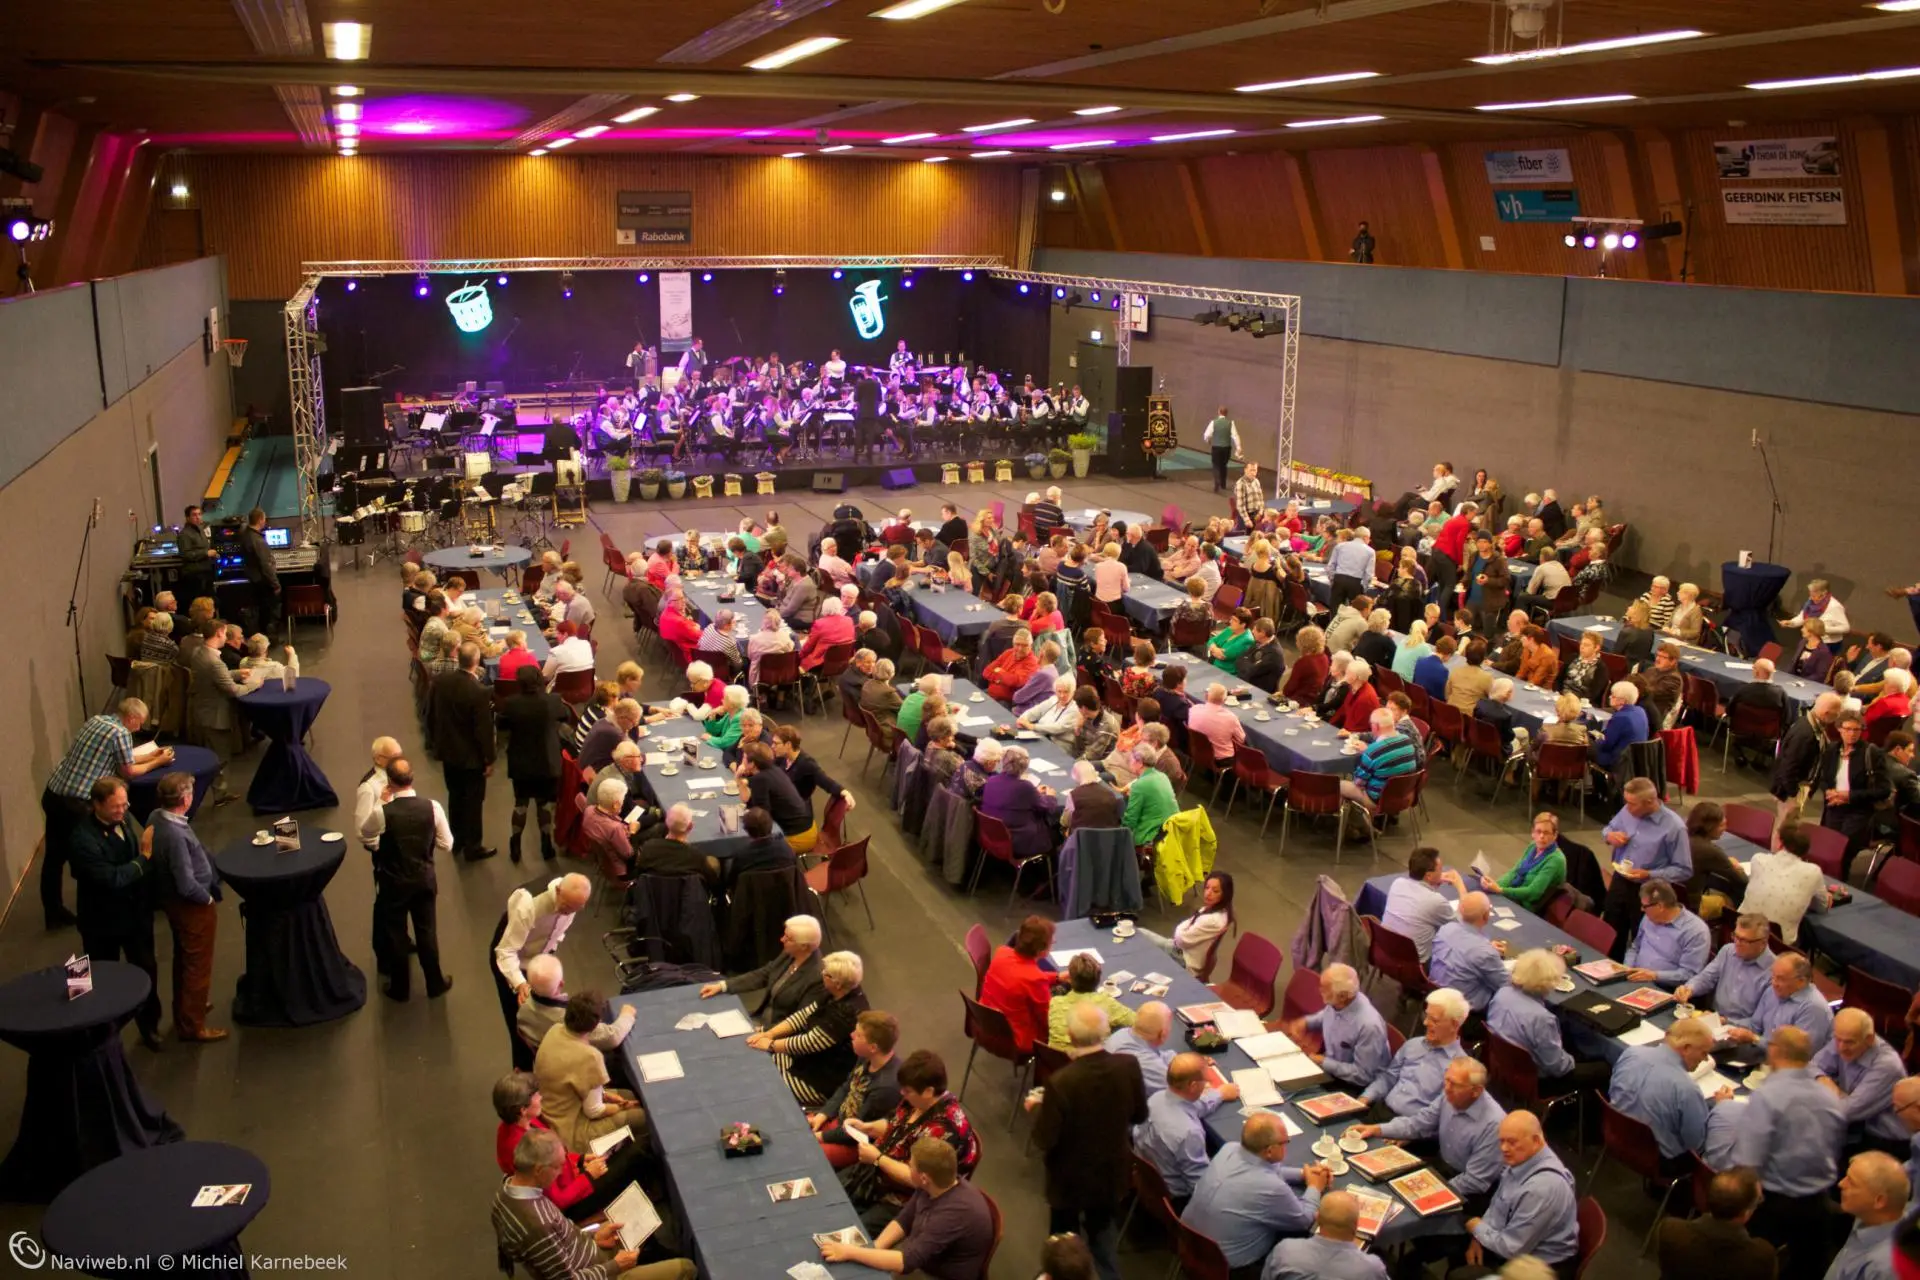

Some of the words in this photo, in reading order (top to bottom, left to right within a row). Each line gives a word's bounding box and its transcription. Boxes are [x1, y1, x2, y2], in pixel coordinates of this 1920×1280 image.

[1725, 192, 1786, 203] GEERDINK
[1788, 191, 1842, 203] FIETSEN
[641, 231, 685, 241] Rabobank
